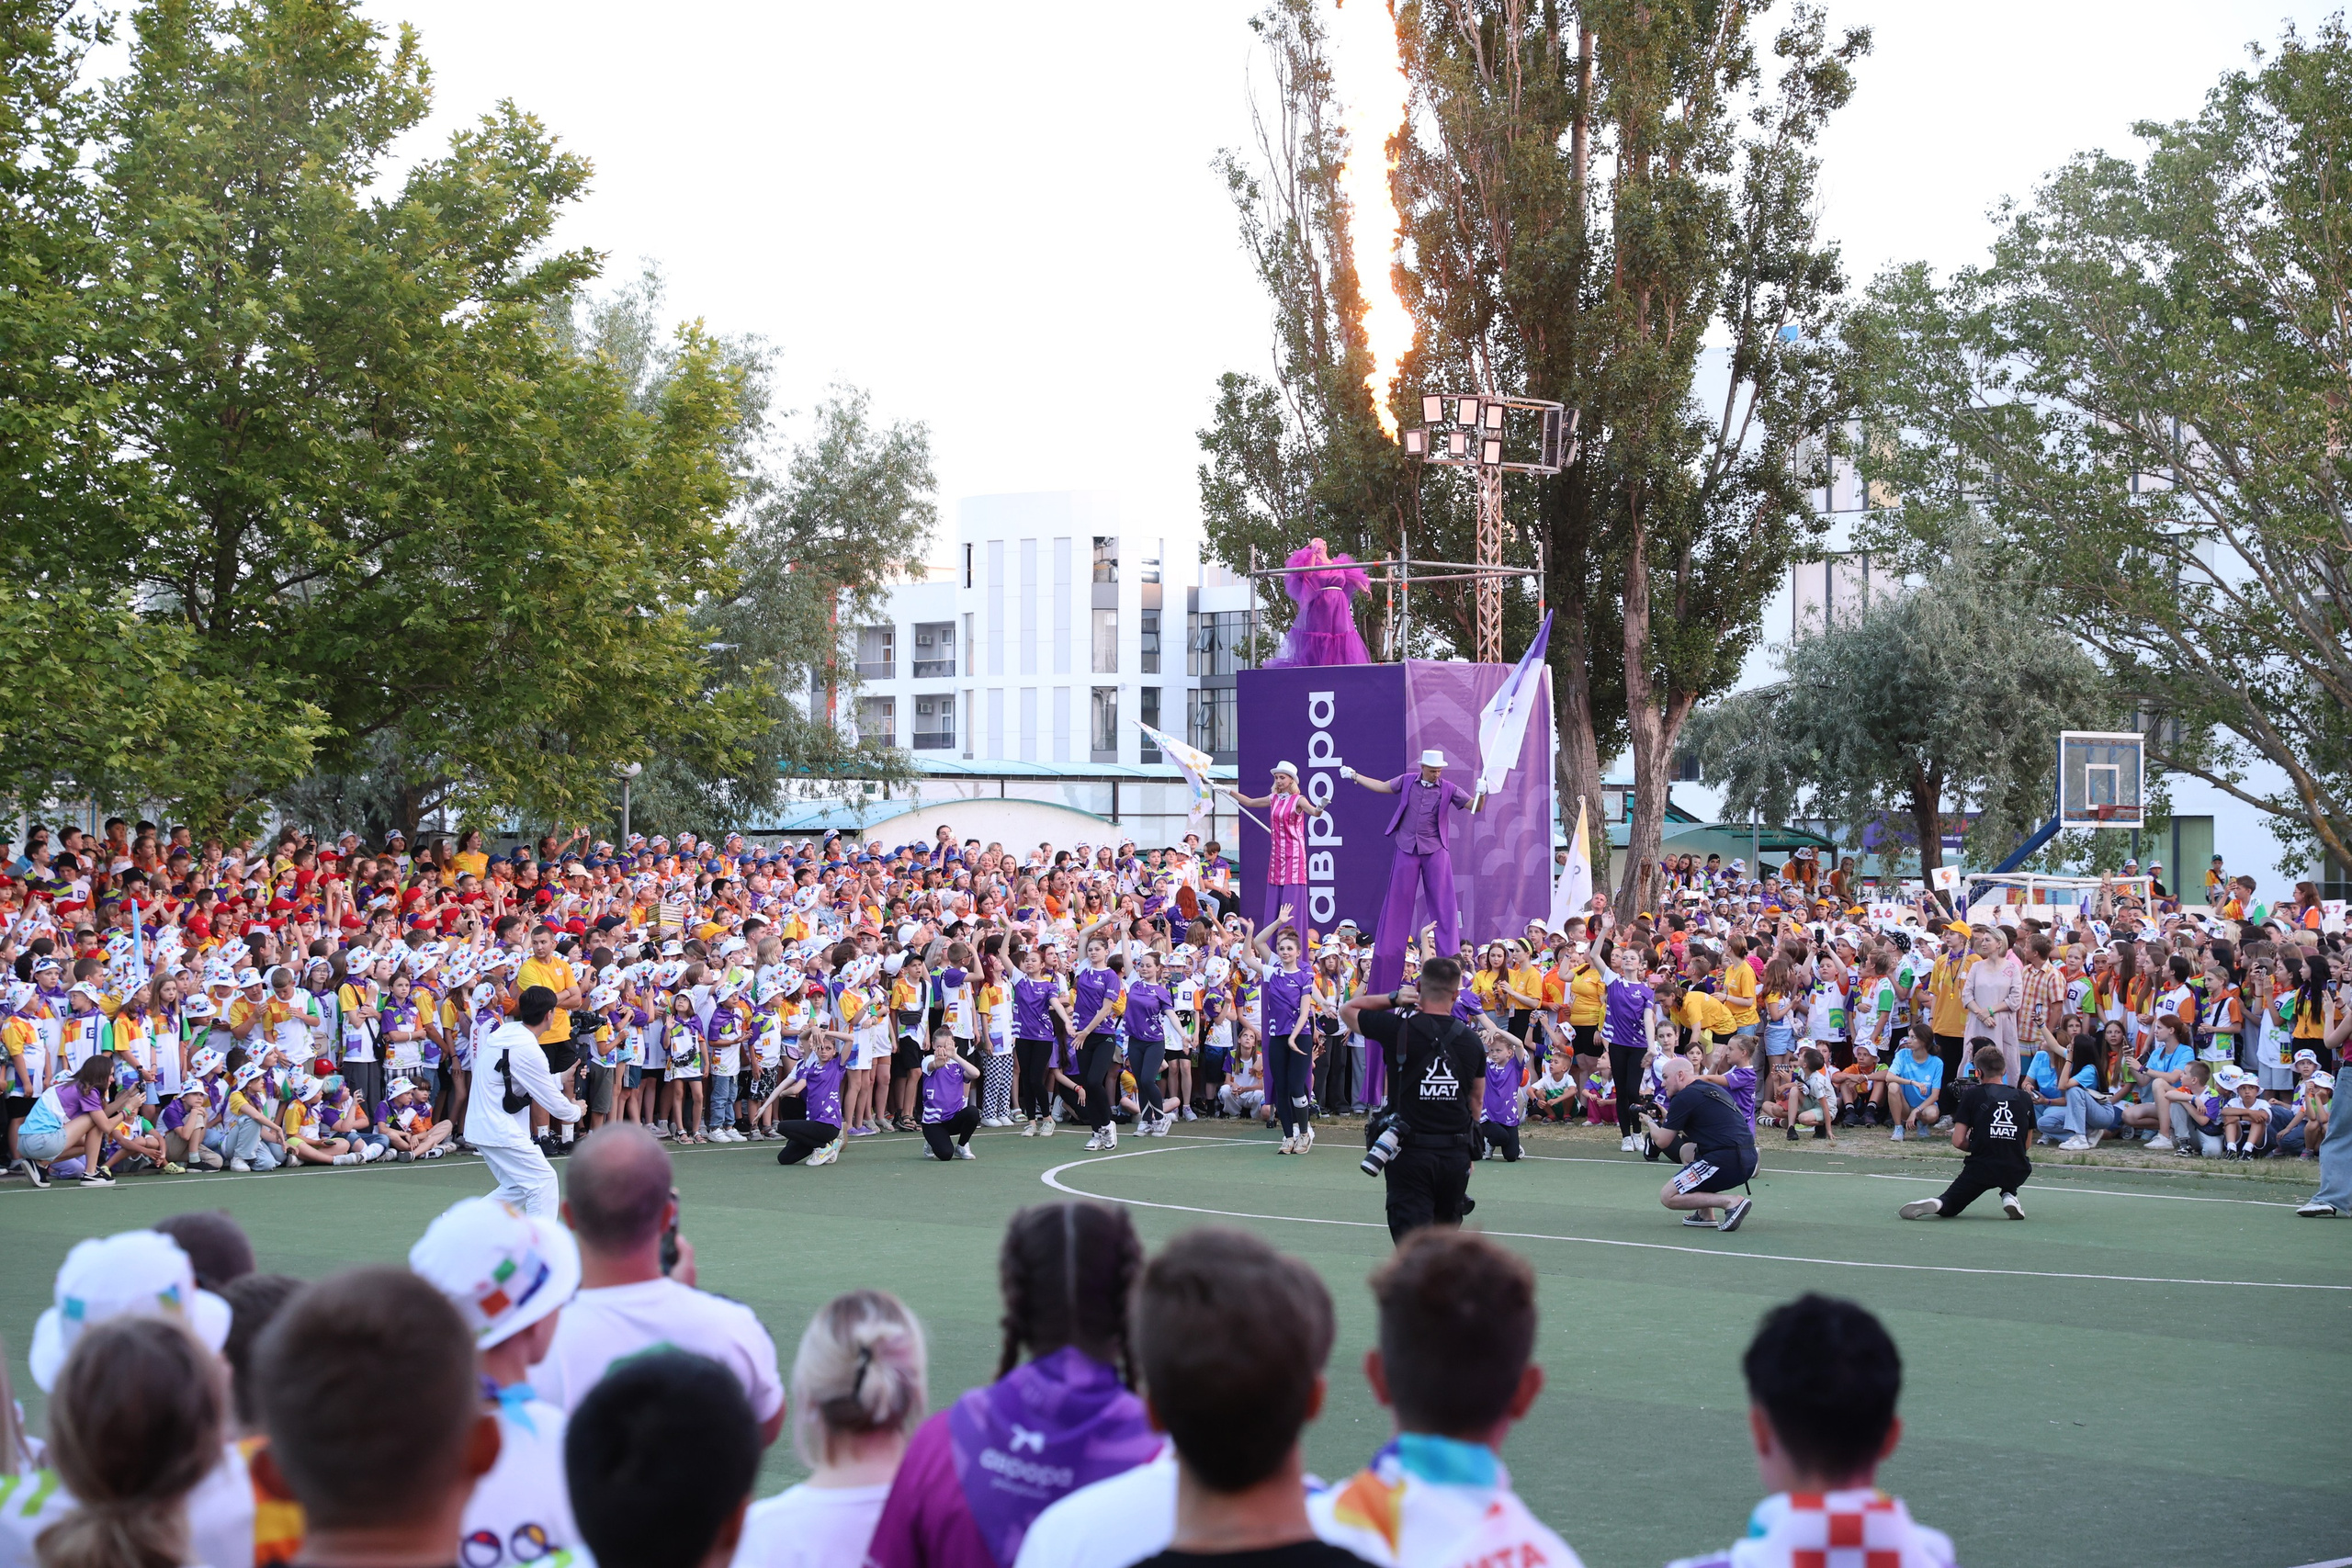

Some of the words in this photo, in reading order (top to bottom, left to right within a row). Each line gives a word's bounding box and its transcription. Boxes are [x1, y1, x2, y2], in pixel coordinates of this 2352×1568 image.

[1307, 691, 1343, 924] аврора
[1940, 871, 1951, 884] 9
[1872, 908, 1894, 919] 16
[2324, 905, 2341, 914] 17
[1419, 1084, 1459, 1097] МАТ
[1989, 1126, 2018, 1137] МАТ
